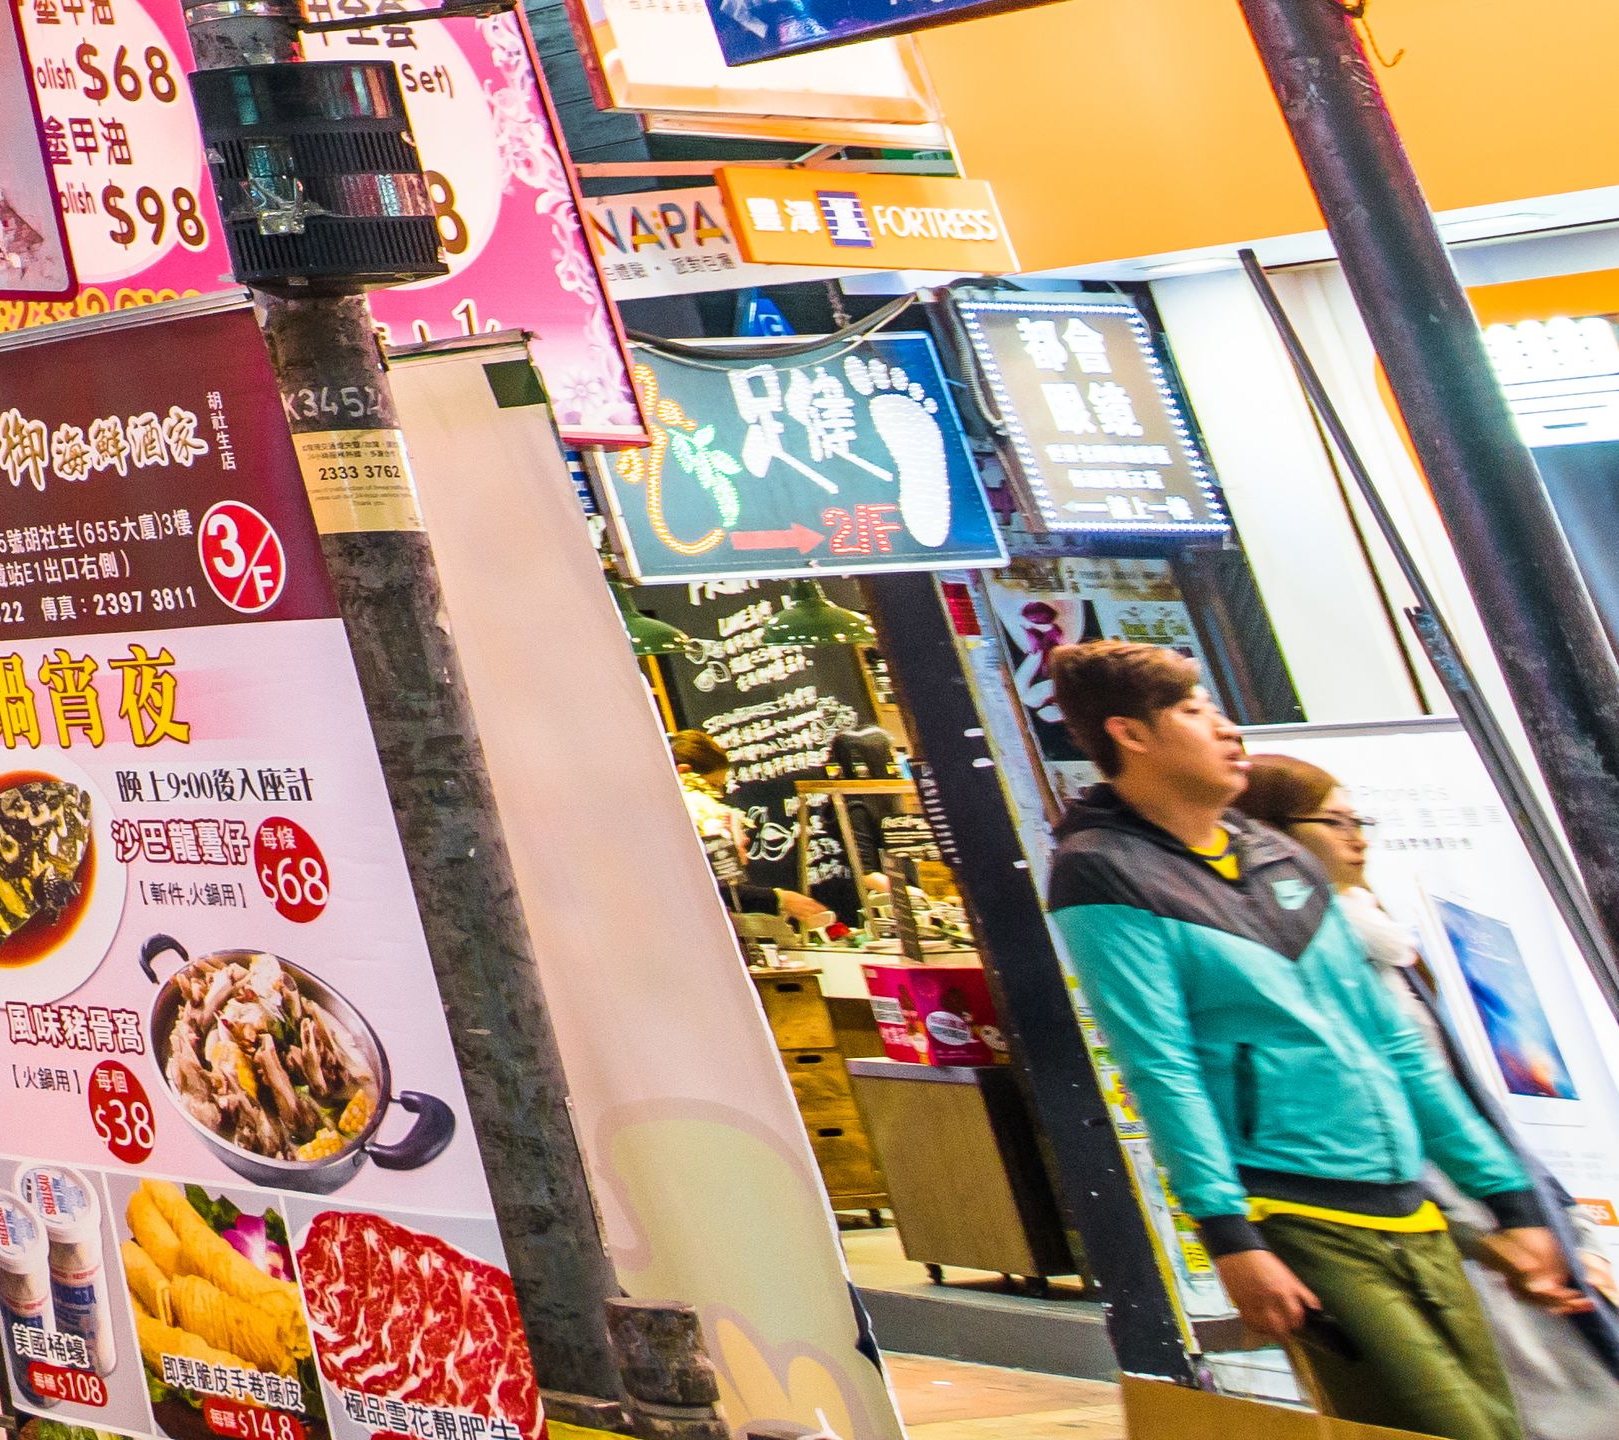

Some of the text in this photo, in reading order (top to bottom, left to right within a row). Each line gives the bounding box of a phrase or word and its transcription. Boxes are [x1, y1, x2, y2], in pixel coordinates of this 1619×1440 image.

[74, 44, 179, 105] $68
[100, 183, 207, 252] $98
[872, 204, 999, 242] FORTRESS
[206, 391, 237, 471] 胡社生店
[318, 463, 401, 481] 2333 3762
[152, 585, 198, 611] 3811
[259, 858, 331, 910] $68
[92, 1099, 156, 1151] $38
